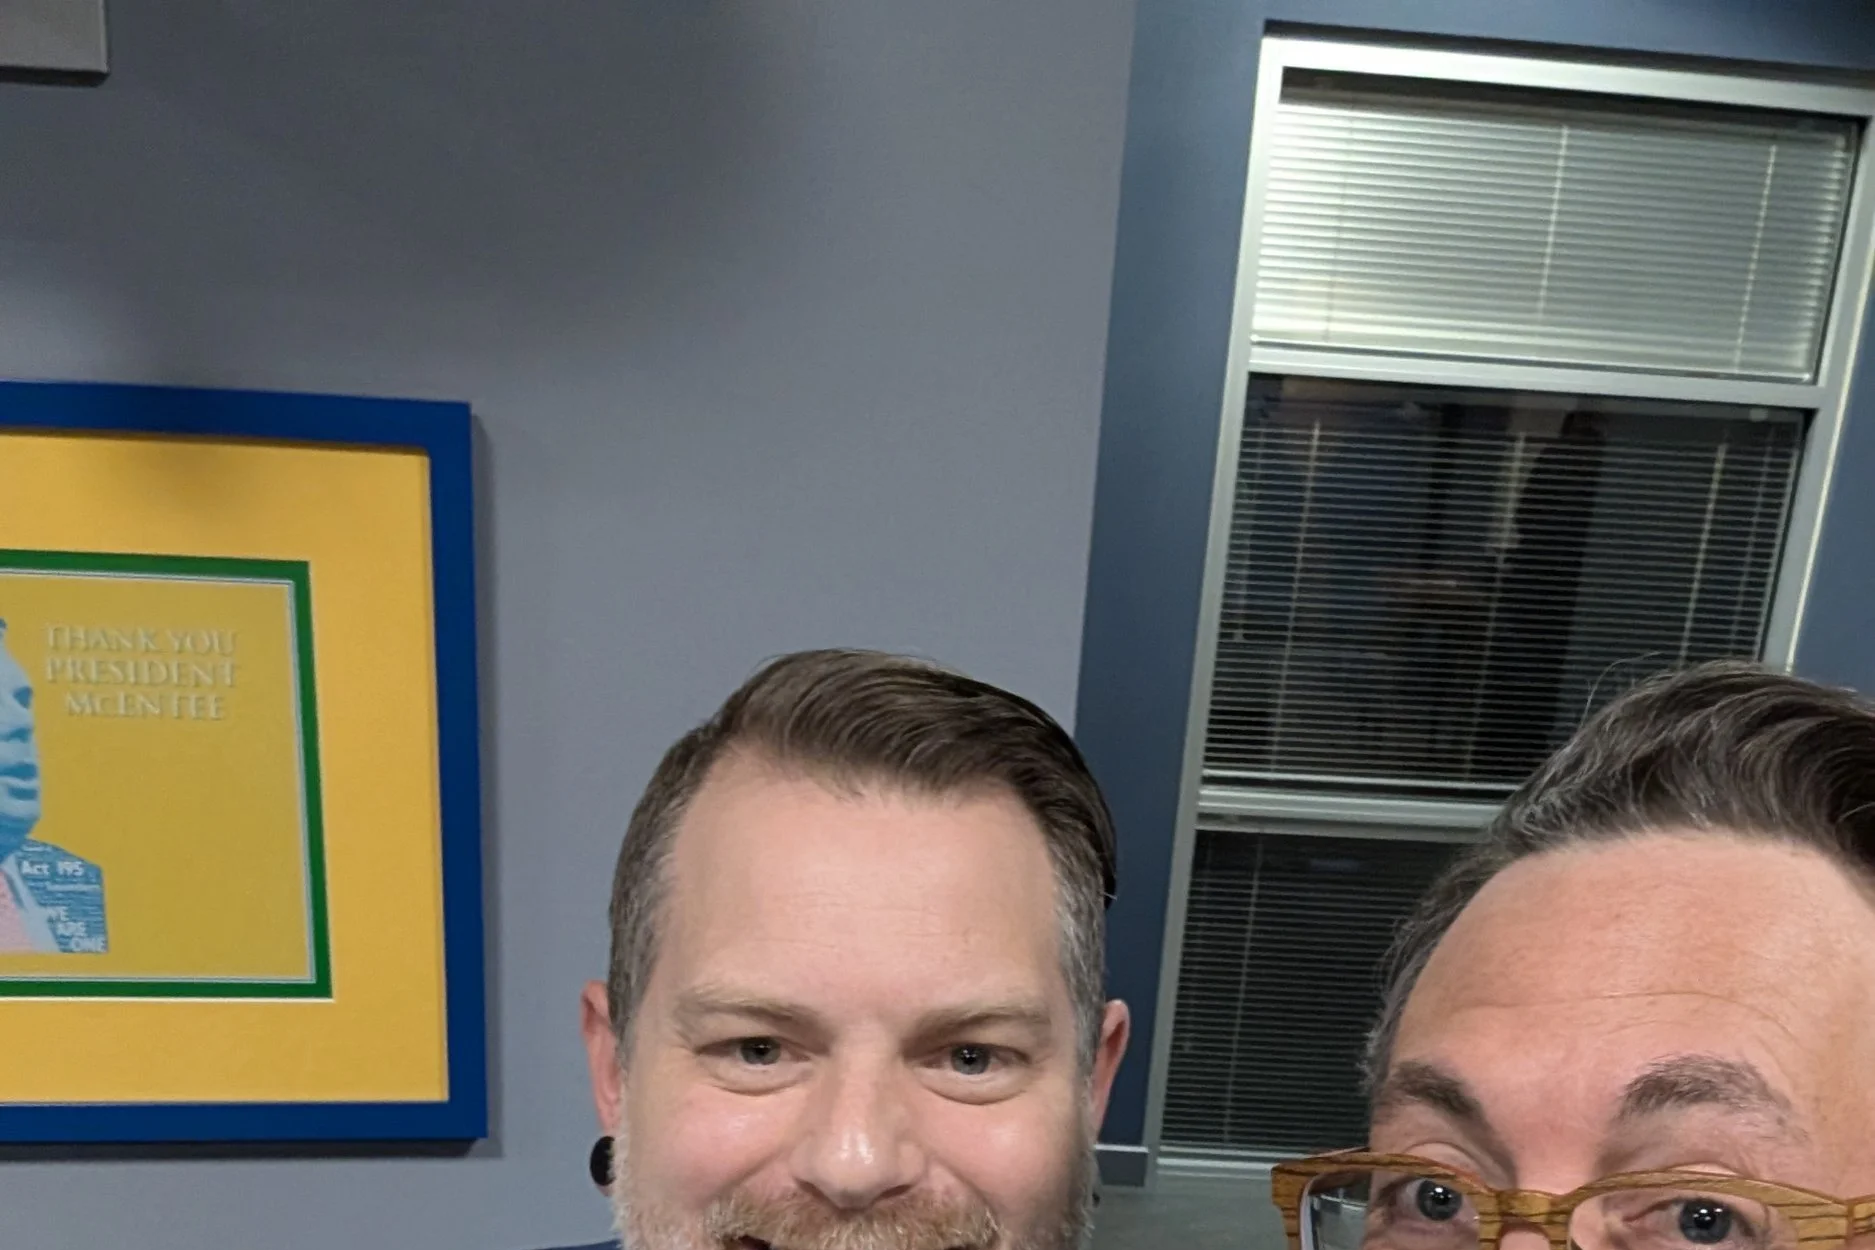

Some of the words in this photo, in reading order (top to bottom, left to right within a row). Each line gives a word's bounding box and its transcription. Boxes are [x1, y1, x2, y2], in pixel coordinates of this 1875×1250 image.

[46, 625, 161, 653] THANK
[167, 629, 237, 655] YOU
[46, 657, 236, 688] PRESIDENT
